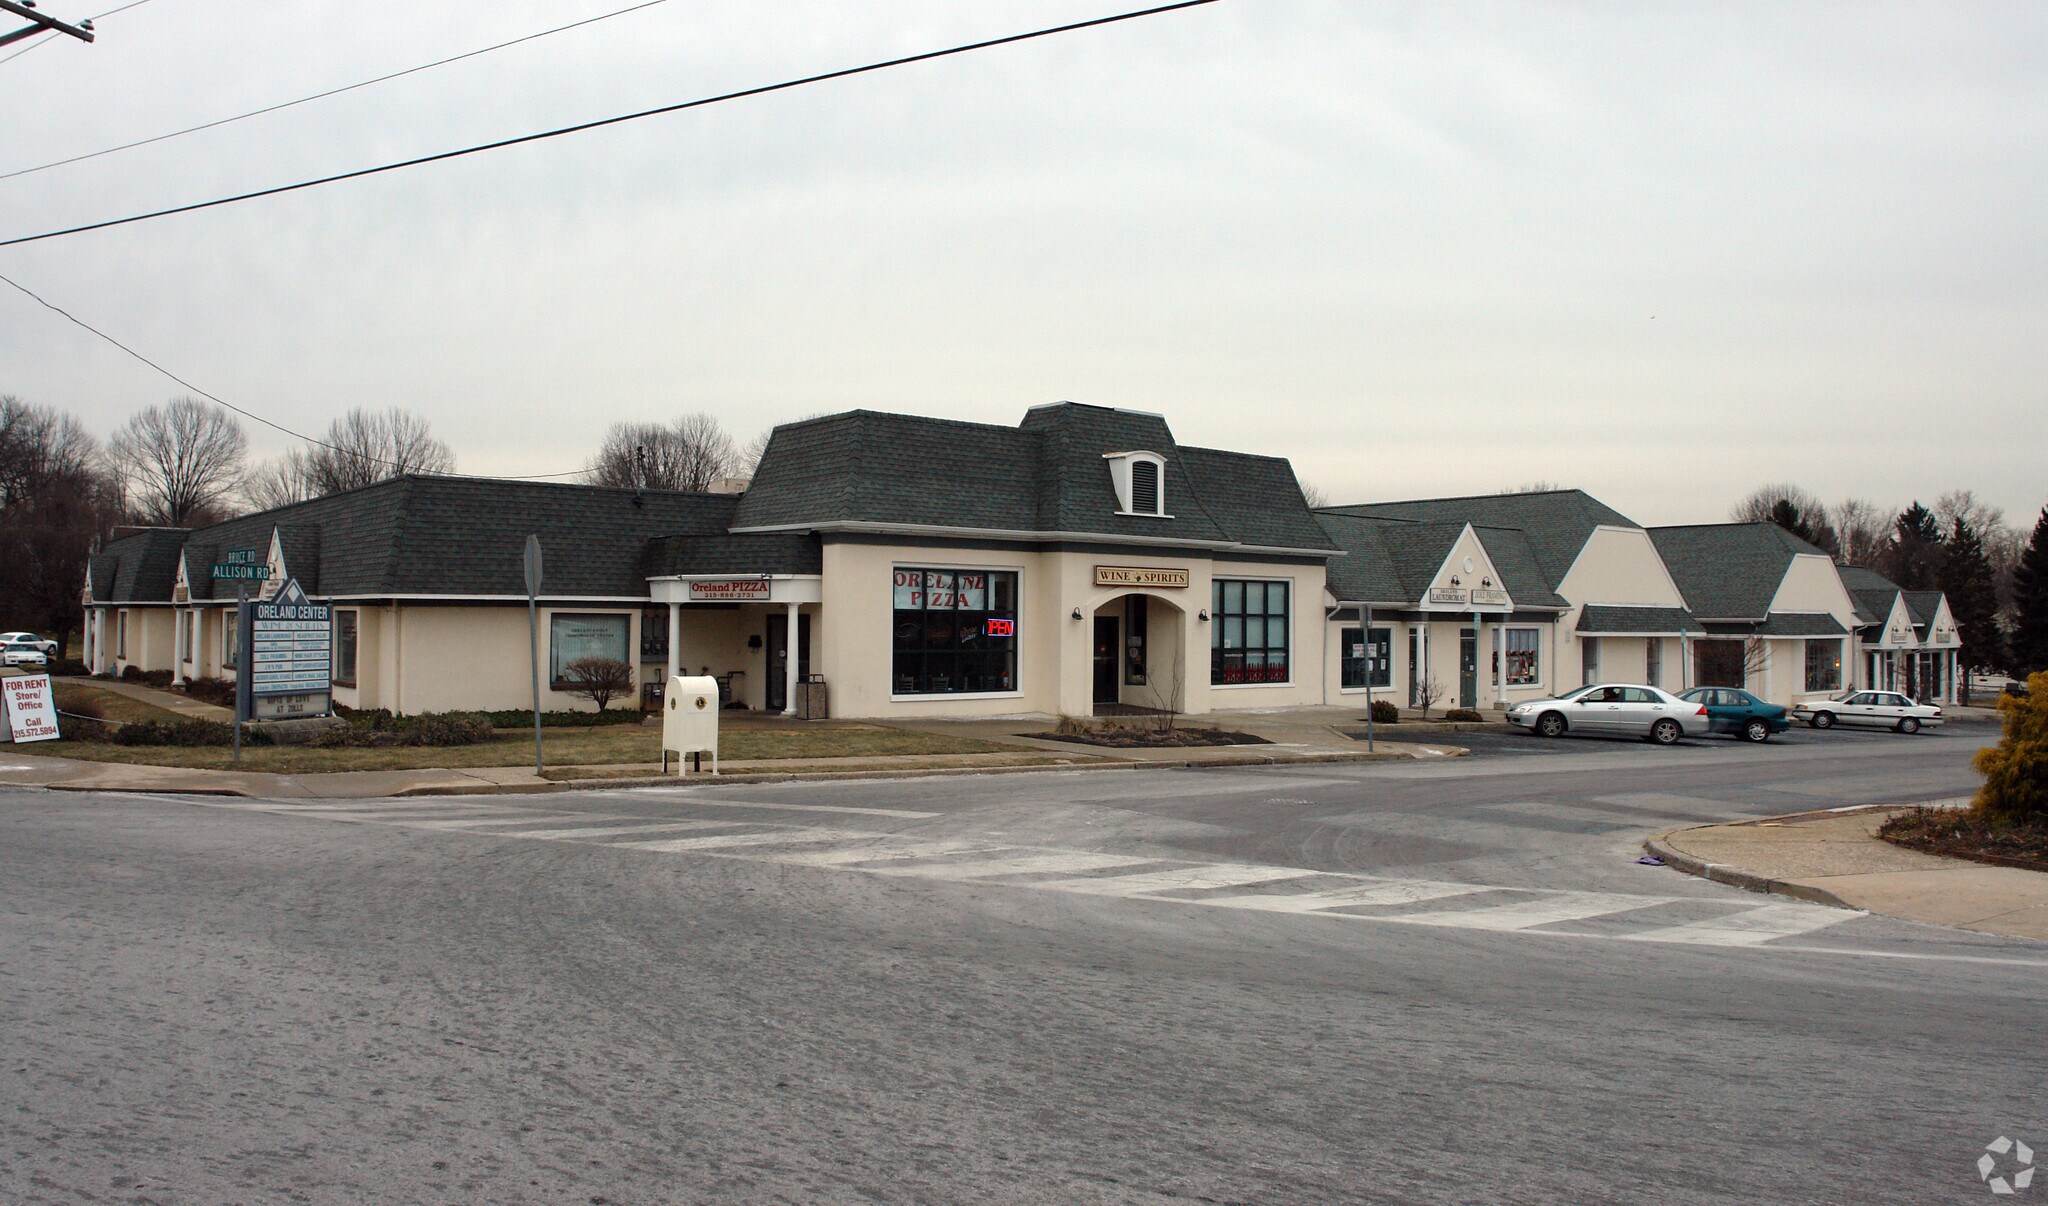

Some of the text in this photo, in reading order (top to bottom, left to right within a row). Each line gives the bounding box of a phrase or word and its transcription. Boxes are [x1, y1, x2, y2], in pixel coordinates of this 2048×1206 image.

[228, 550, 255, 563] BRUCE RD
[213, 565, 269, 579] ALLISON RD
[1100, 571, 1185, 583] WINE SPIRITS
[692, 581, 768, 592] Oreland PIZZA
[258, 605, 328, 619] ORELAND CENTER
[987, 621, 1013, 635] PEN
[5, 679, 47, 691] FOR RENT
[15, 689, 41, 701] Store/
[18, 701, 43, 711] Office
[276, 704, 304, 713] AT ZOLLS
[25, 717, 42, 727] Call
